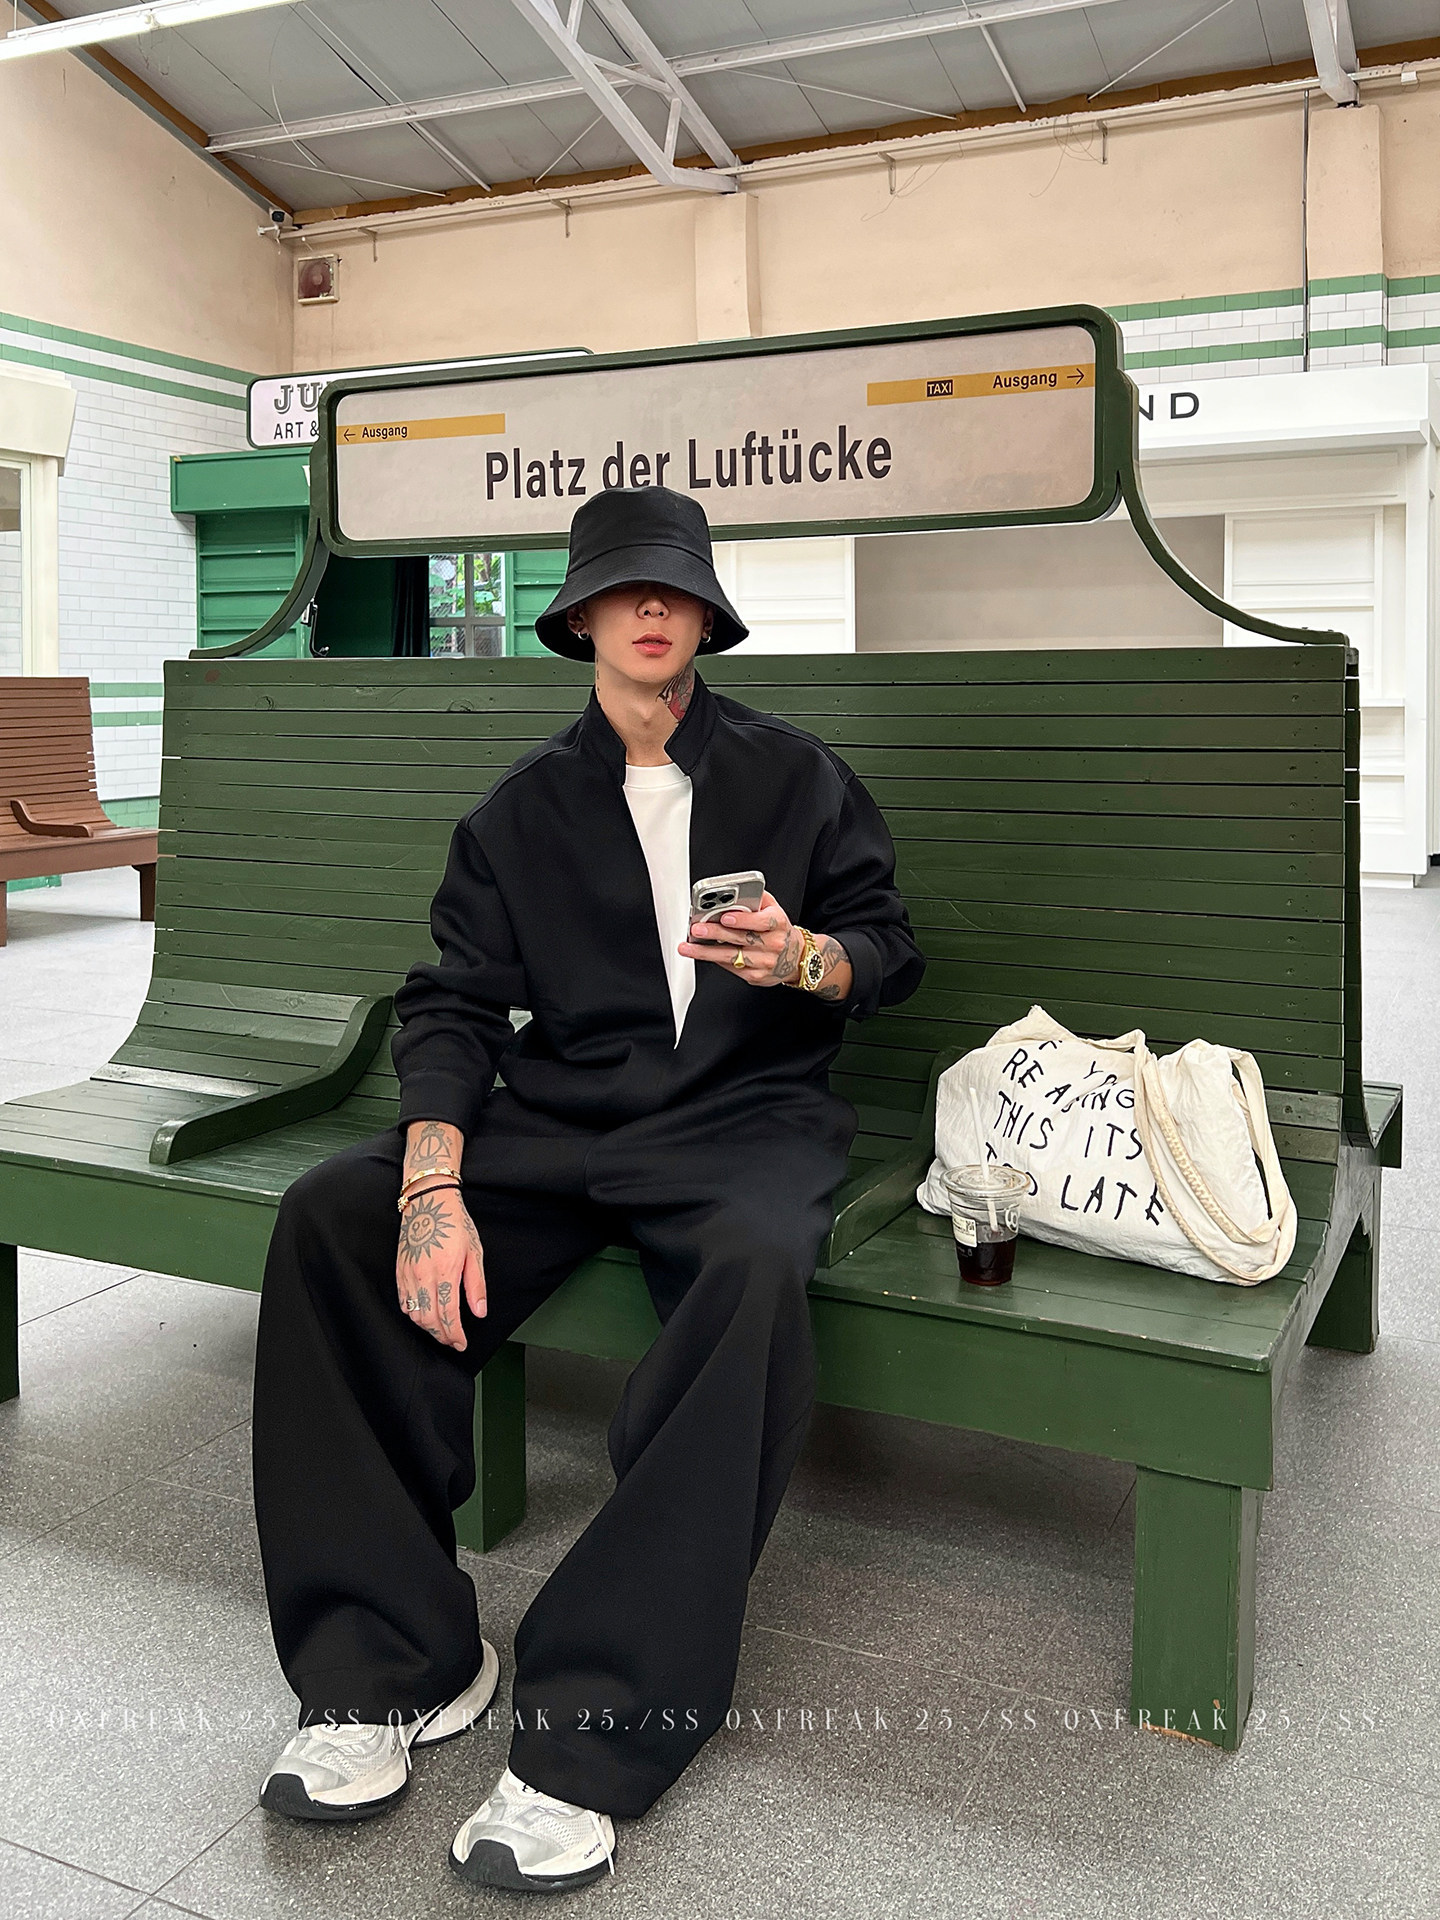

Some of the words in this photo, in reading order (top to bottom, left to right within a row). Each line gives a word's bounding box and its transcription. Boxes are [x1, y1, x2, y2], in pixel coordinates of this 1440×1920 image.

[274, 381, 330, 414] JU
[927, 381, 953, 396] TAXI
[992, 373, 1057, 390] Ausgang
[273, 421, 304, 440] ART
[310, 420, 320, 437] &
[361, 426, 408, 440] Ausgang
[486, 447, 587, 500] Platz
[602, 440, 670, 490] der
[688, 424, 892, 490] Luftücke
[993, 1090, 1054, 1150] THIS
[1084, 1122, 1143, 1160] ITS
[1060, 1174, 1164, 1226] LATE
